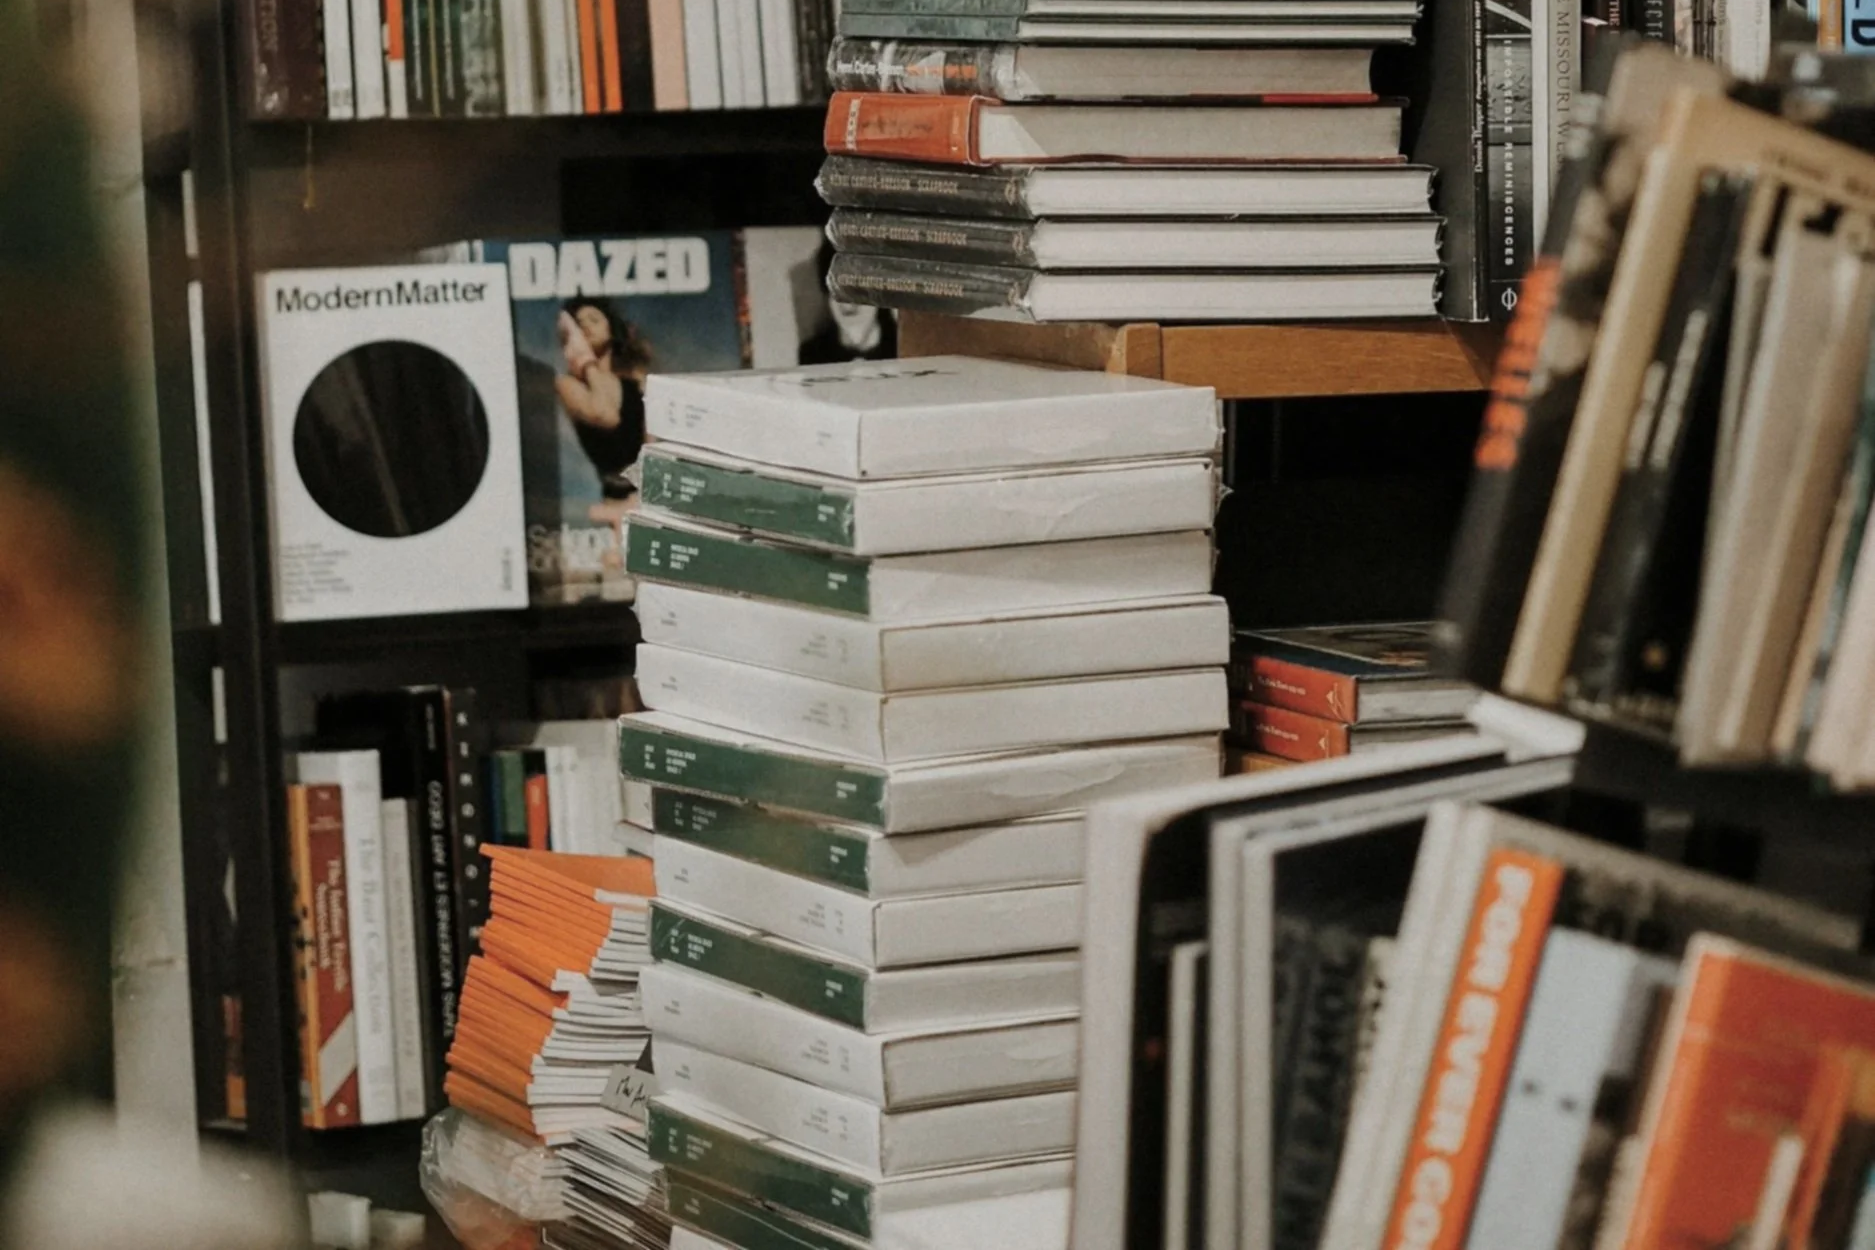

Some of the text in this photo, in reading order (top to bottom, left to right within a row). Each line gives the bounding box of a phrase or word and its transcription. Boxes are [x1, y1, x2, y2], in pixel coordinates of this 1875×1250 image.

[1607, 0, 1620, 27] THE
[1556, 12, 1571, 114] MISSOURI
[1503, 39, 1515, 266] IMPOSSIBLE REMINISCENCES
[508, 237, 711, 300] DAZED
[275, 277, 488, 314] ModernMatter
[430, 833, 446, 866] ART
[433, 870, 448, 893] ET
[436, 894, 454, 989] MODERNES
[441, 990, 457, 1038] TAPIS
